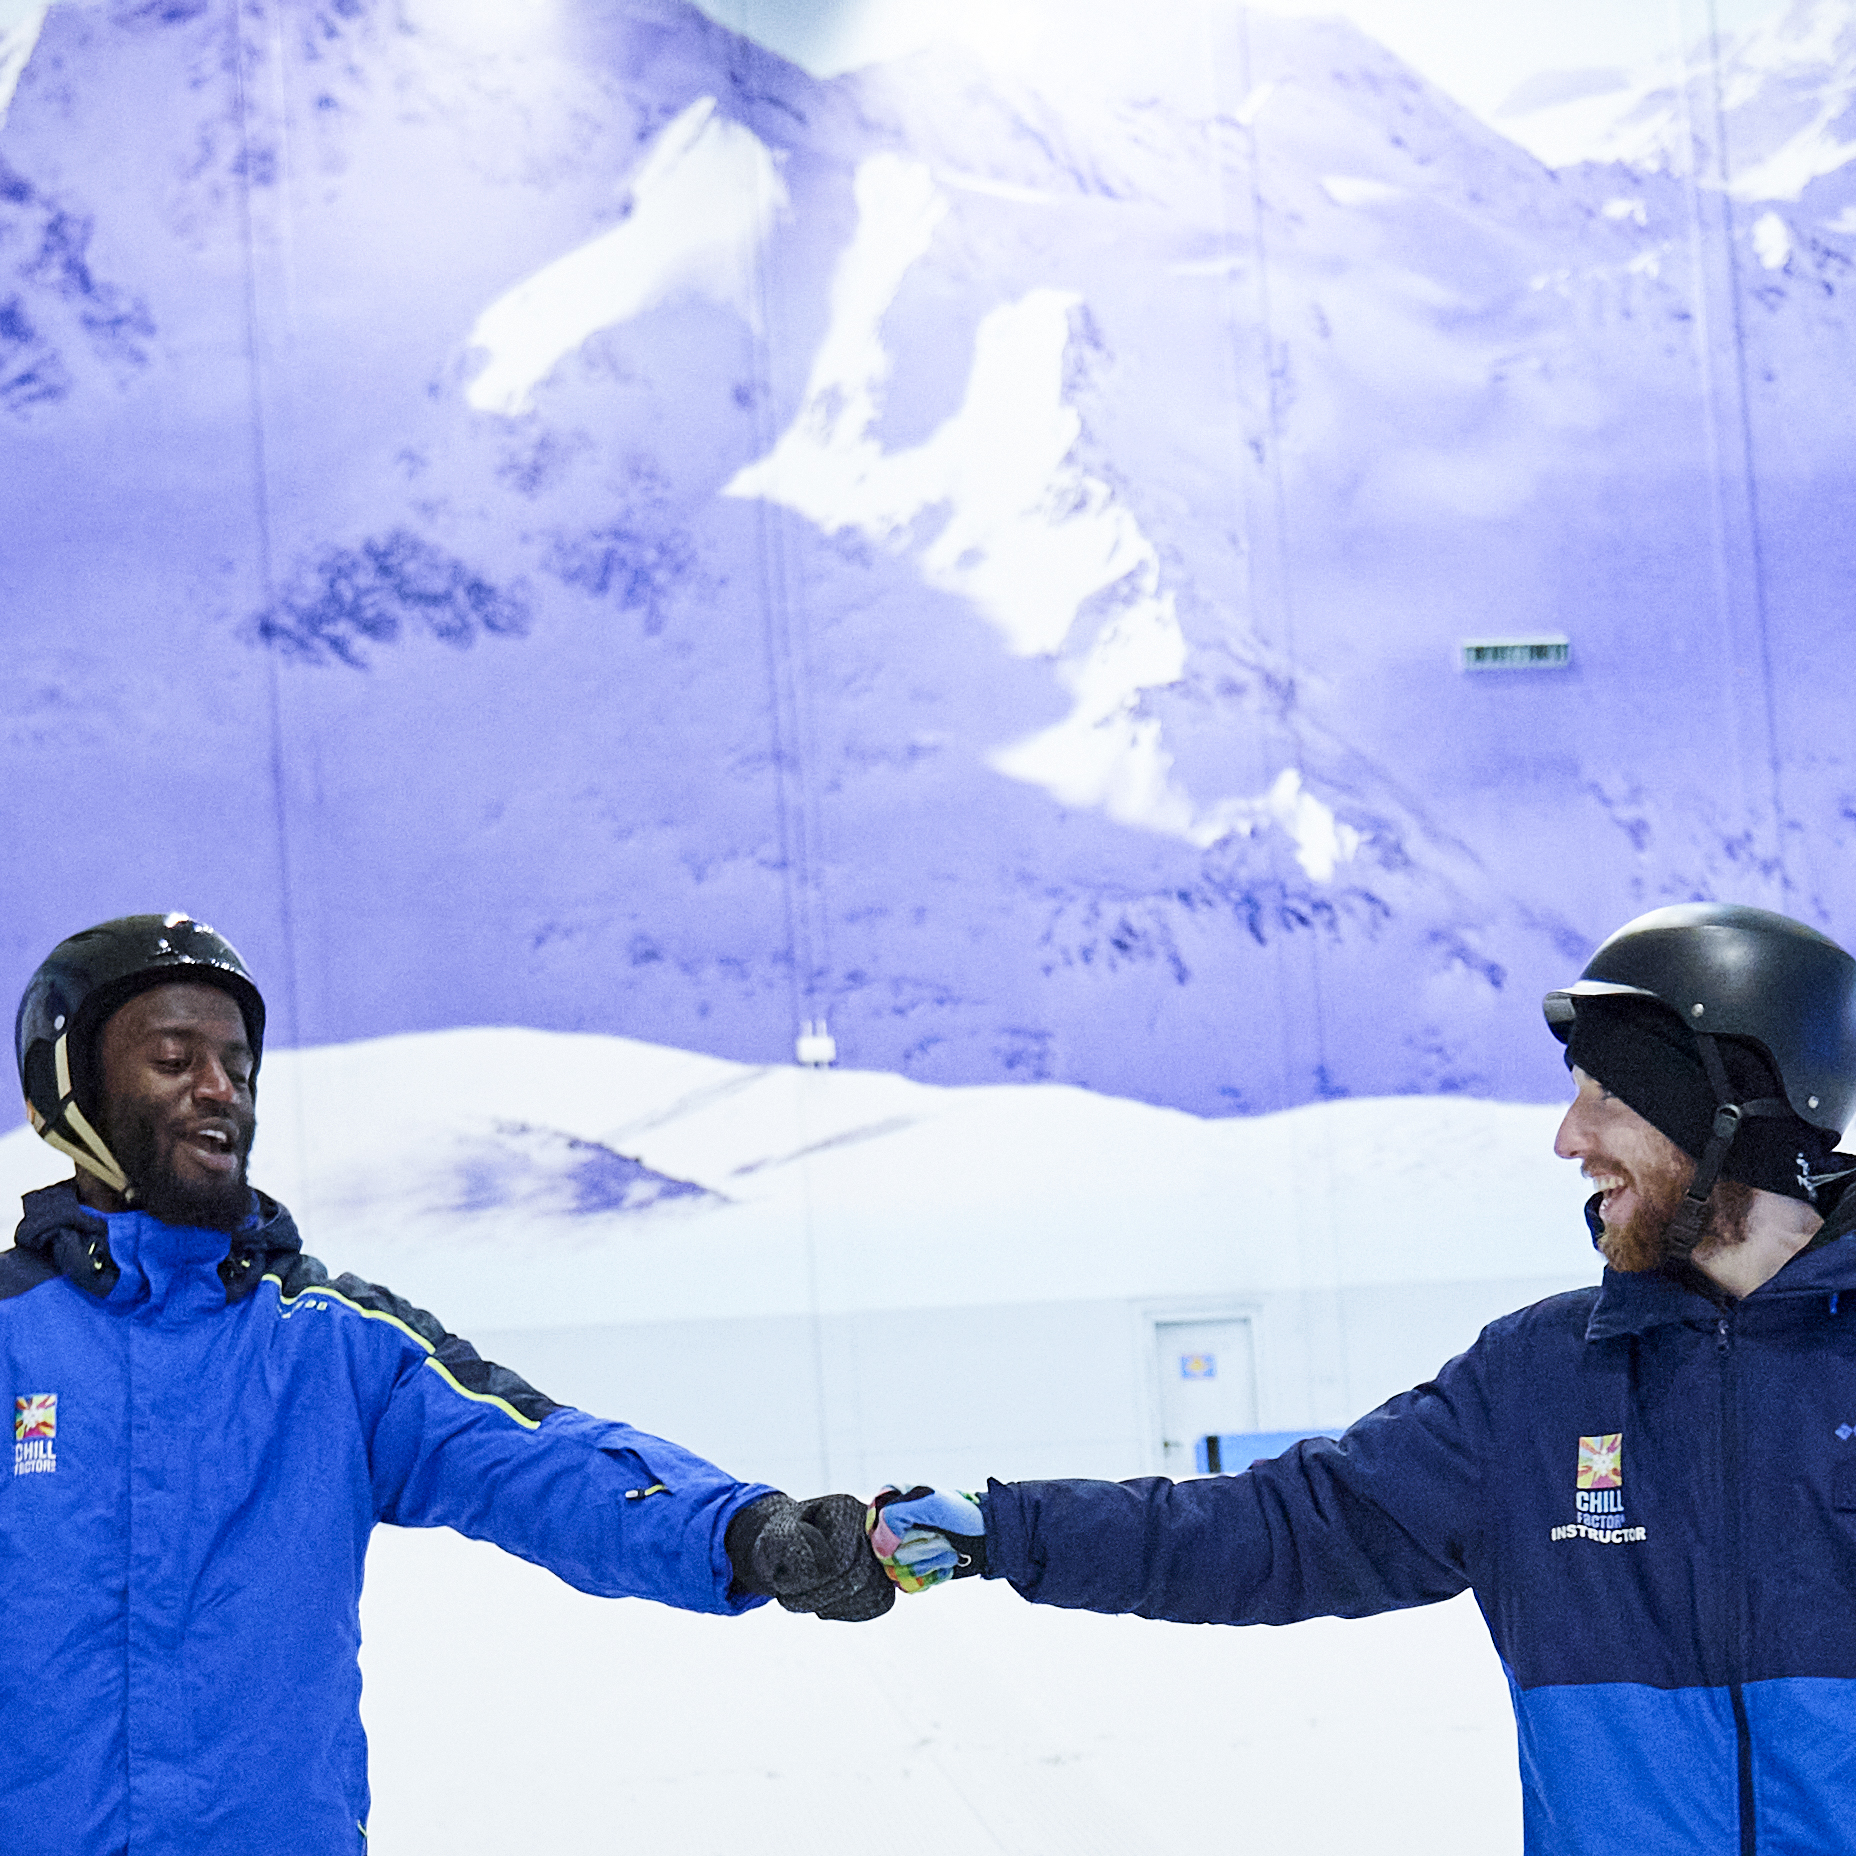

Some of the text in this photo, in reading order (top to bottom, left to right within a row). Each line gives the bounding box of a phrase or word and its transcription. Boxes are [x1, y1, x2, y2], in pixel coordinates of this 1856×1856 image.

[15, 1439, 57, 1463] CHILL
[1575, 1489, 1625, 1513] CHILL
[1551, 1524, 1647, 1544] INSTRUCTOR
